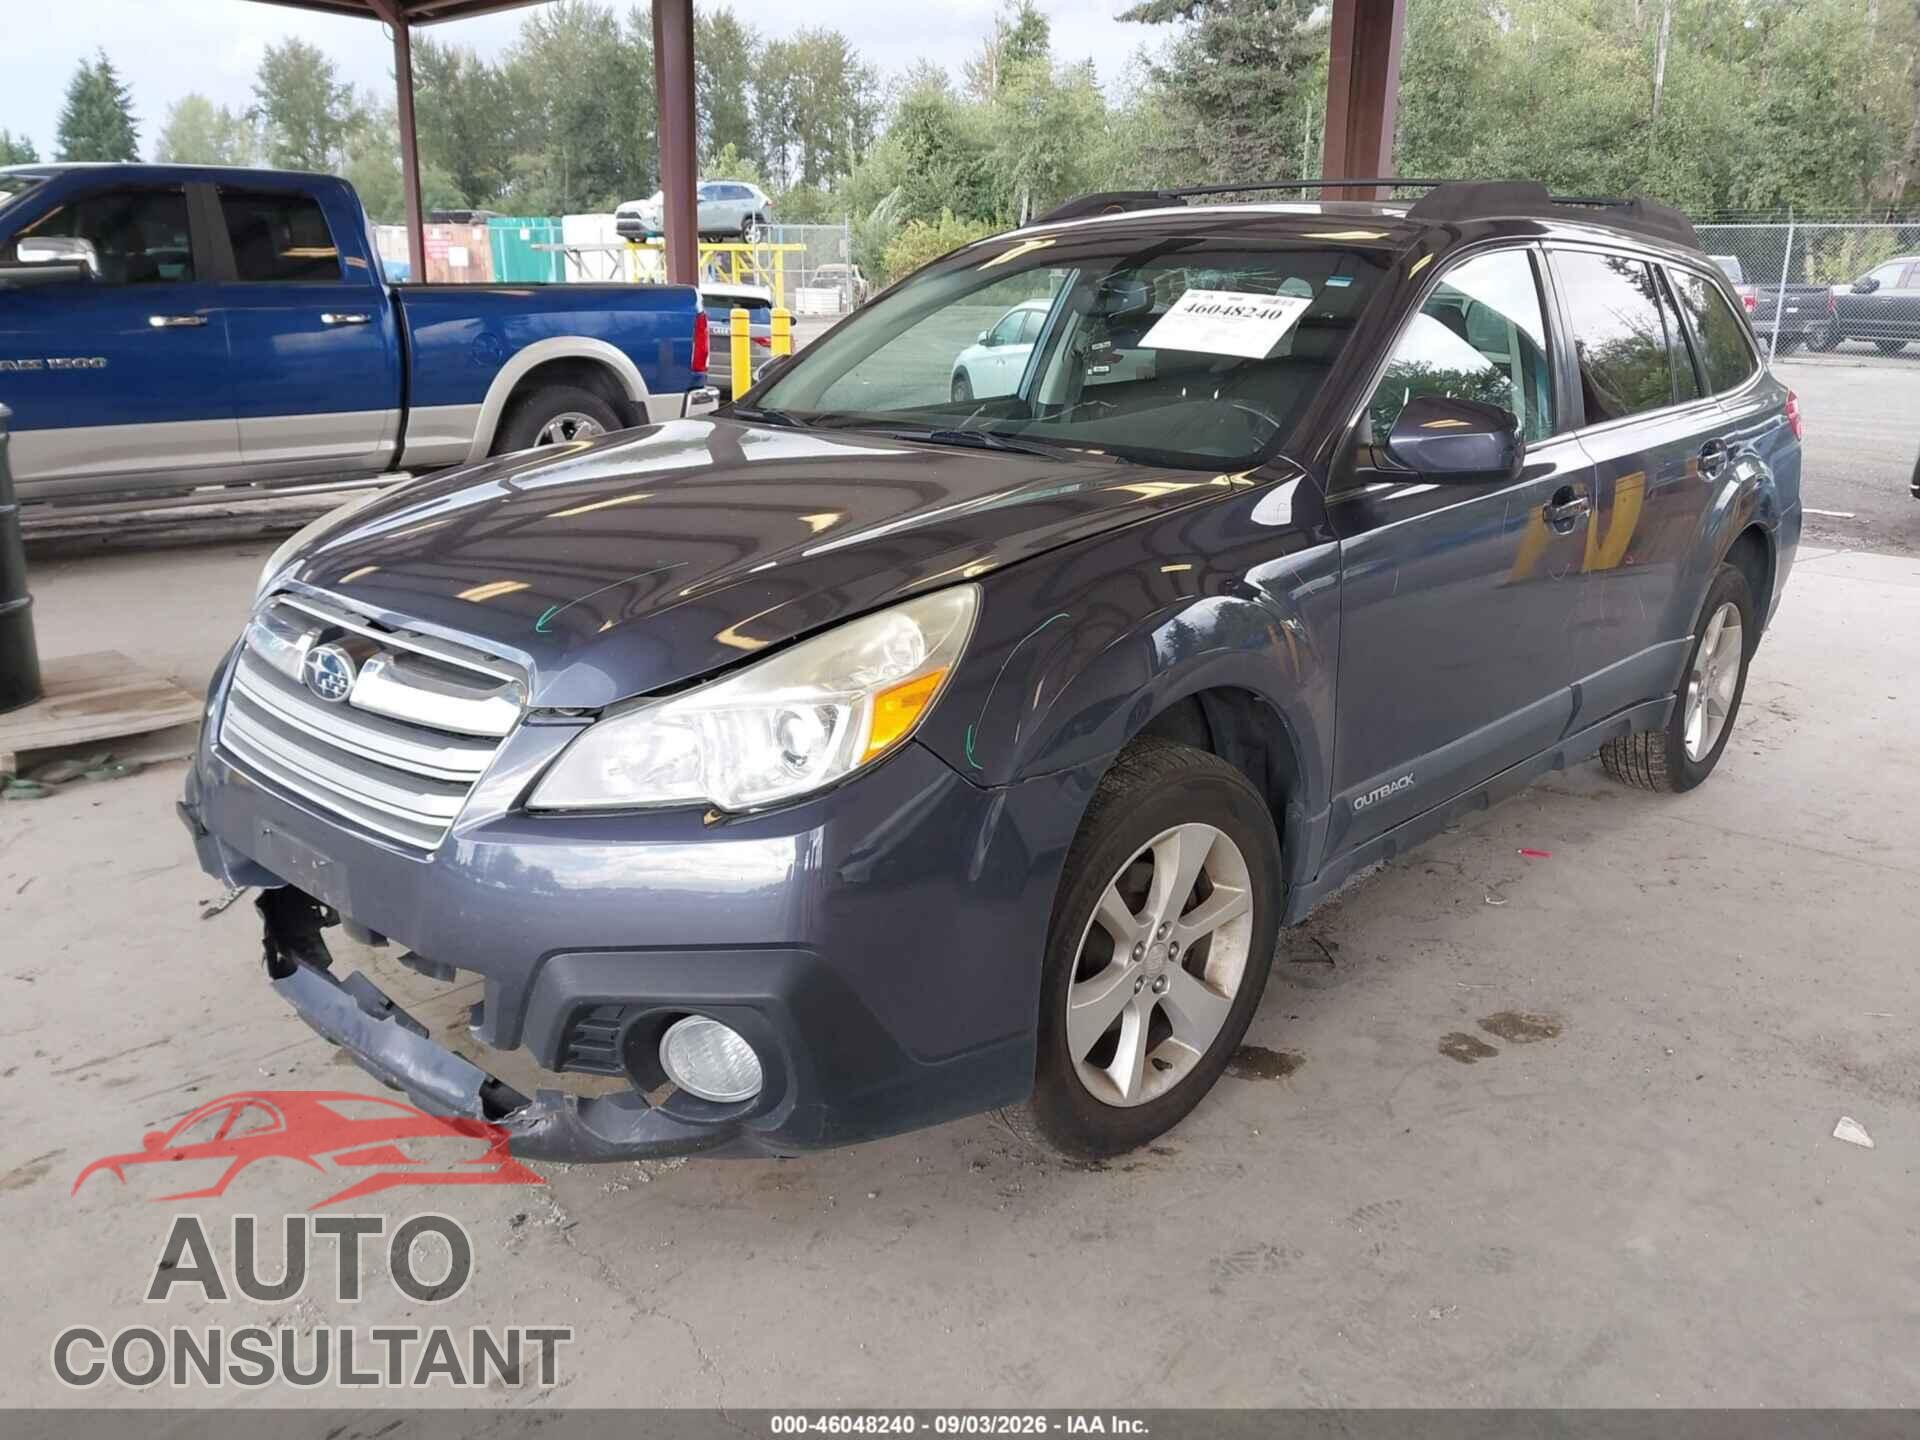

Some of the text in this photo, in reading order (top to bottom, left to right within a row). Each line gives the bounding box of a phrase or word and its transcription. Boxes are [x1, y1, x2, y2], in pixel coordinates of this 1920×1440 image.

[1184, 303, 1283, 320] 46048240
[0, 359, 42, 370] AM
[1353, 773, 1415, 811] OUTBACK
